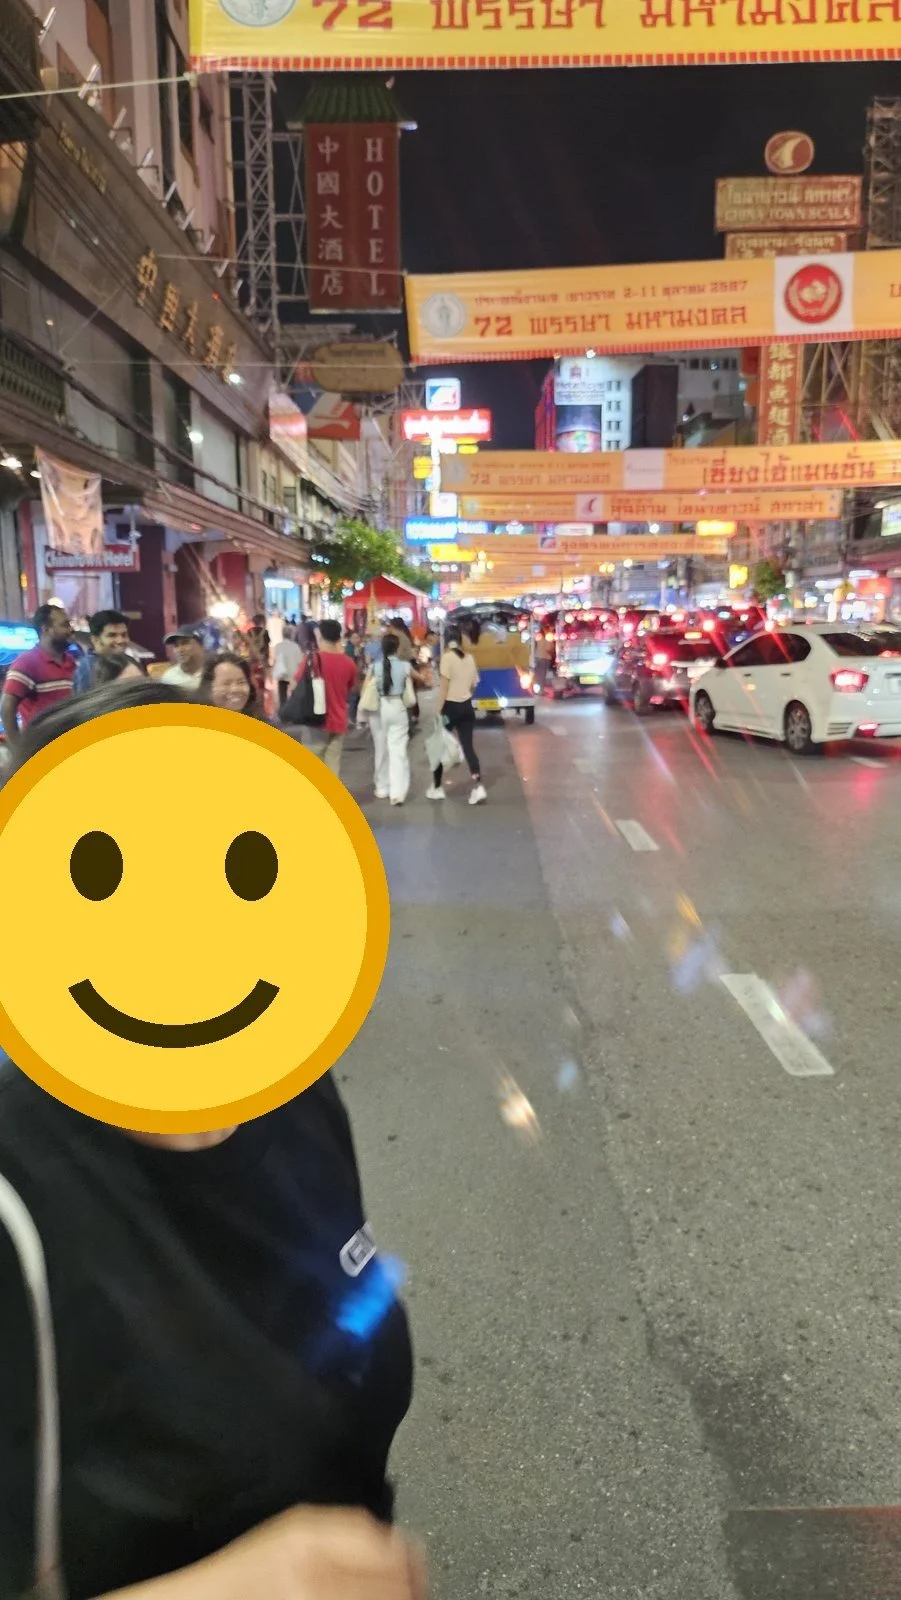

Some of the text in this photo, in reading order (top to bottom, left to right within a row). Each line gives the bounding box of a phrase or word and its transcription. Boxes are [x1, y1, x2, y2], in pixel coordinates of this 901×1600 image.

[312, 0, 393, 31] 72
[316, 135, 344, 296] 中國大酒店
[364, 137, 386, 297] HOTEL
[623, 286, 656, 299] 2-11
[474, 306, 748, 338] 72 พรรษา มหามงคล
